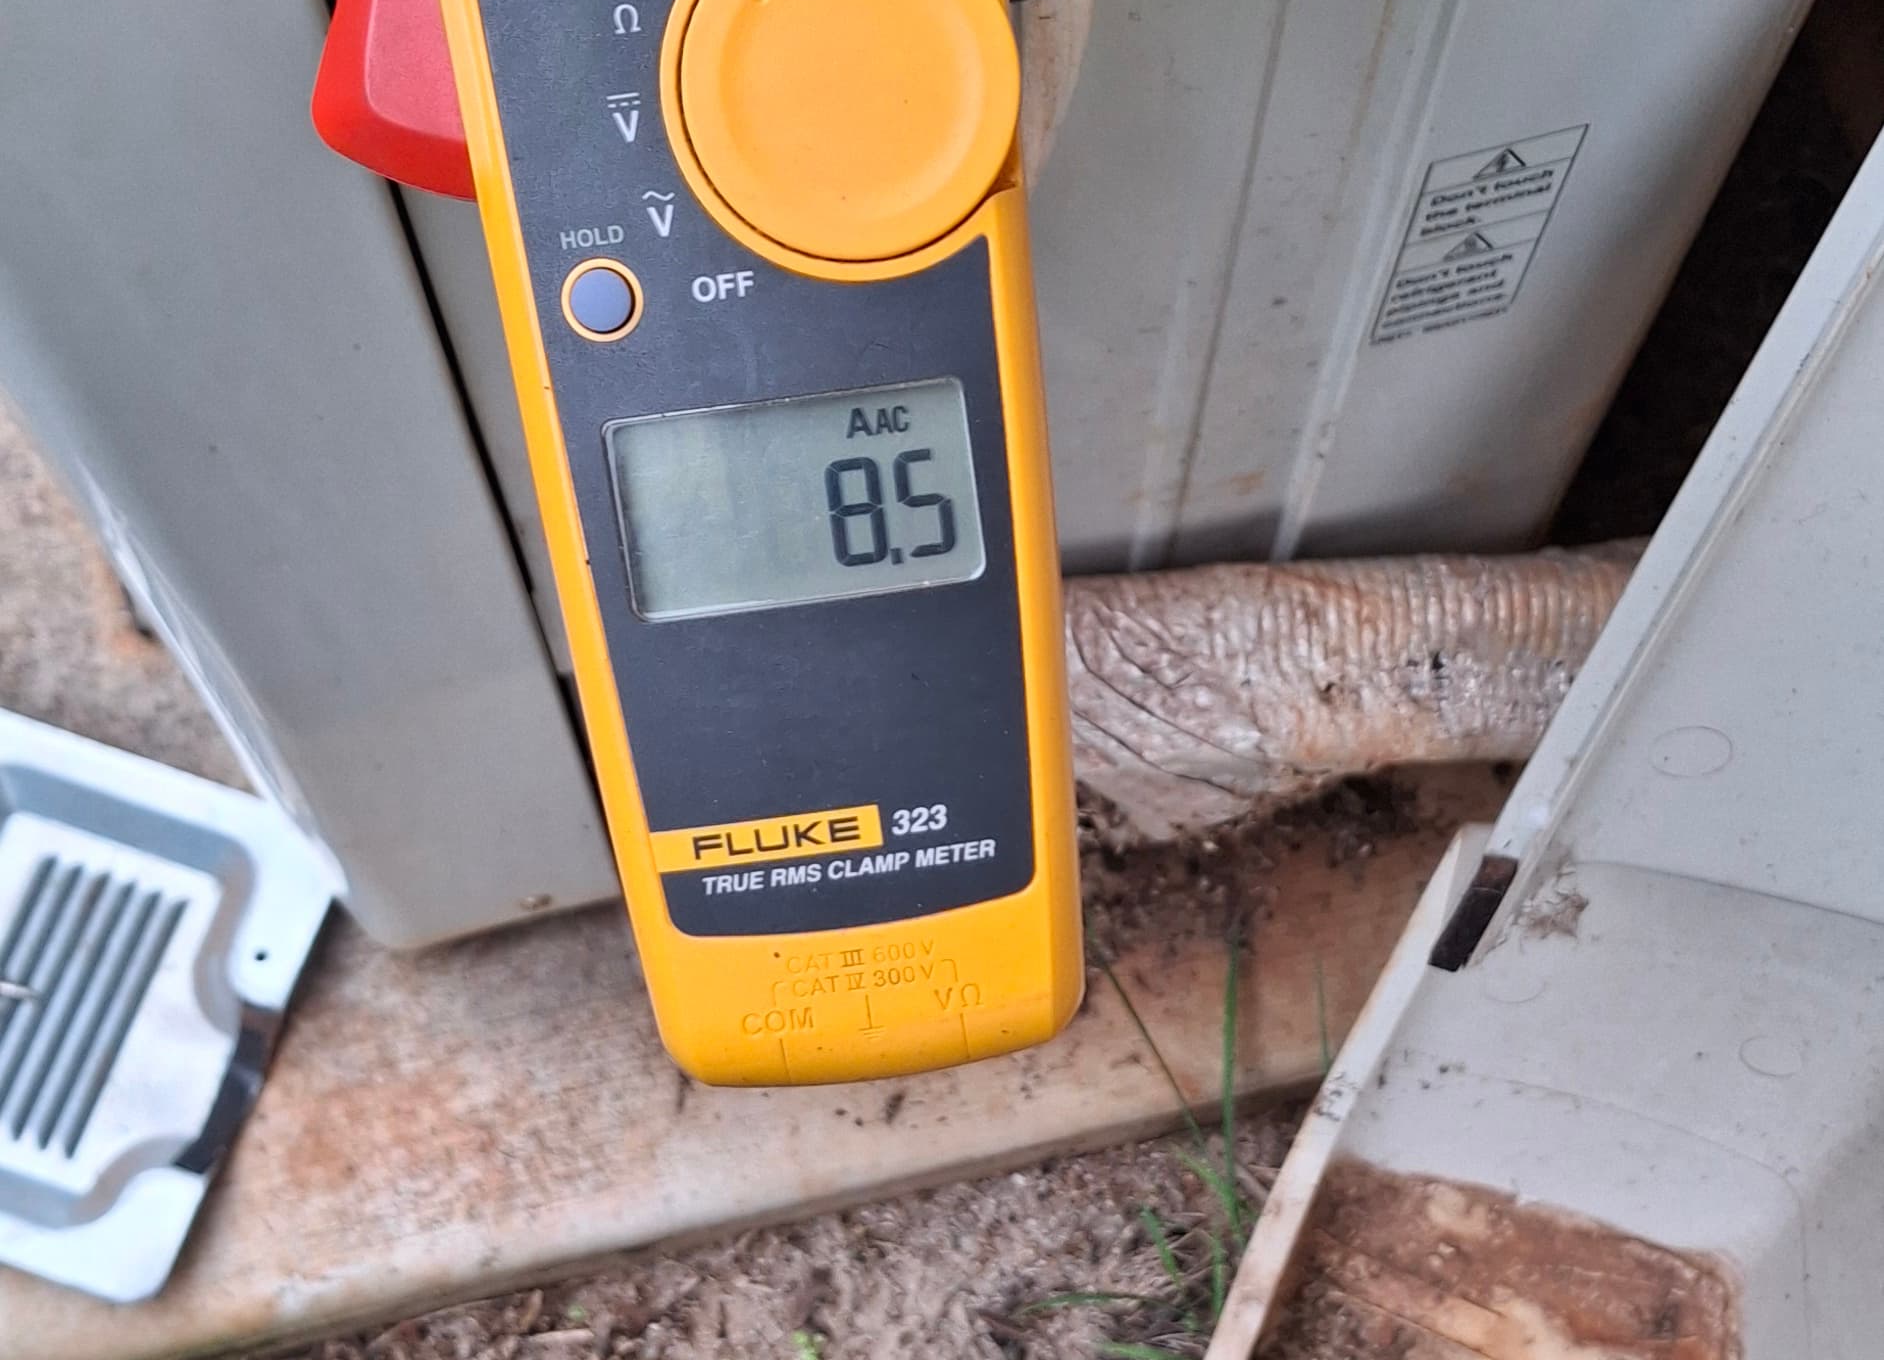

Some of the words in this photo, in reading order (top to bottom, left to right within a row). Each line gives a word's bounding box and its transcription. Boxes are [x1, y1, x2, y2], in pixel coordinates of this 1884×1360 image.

[560, 225, 624, 249] HOLD
[692, 271, 754, 302] OFF
[824, 448, 955, 567] 8.5
[693, 816, 861, 860] FLUKE
[892, 805, 947, 836] 323
[702, 871, 764, 895] TRUE
[771, 864, 822, 887] RMS
[828, 853, 910, 880] CLAMP
[916, 840, 995, 868] METER
[787, 953, 833, 974] CAT
[793, 975, 839, 997] CAT
[742, 1007, 814, 1034] COM
